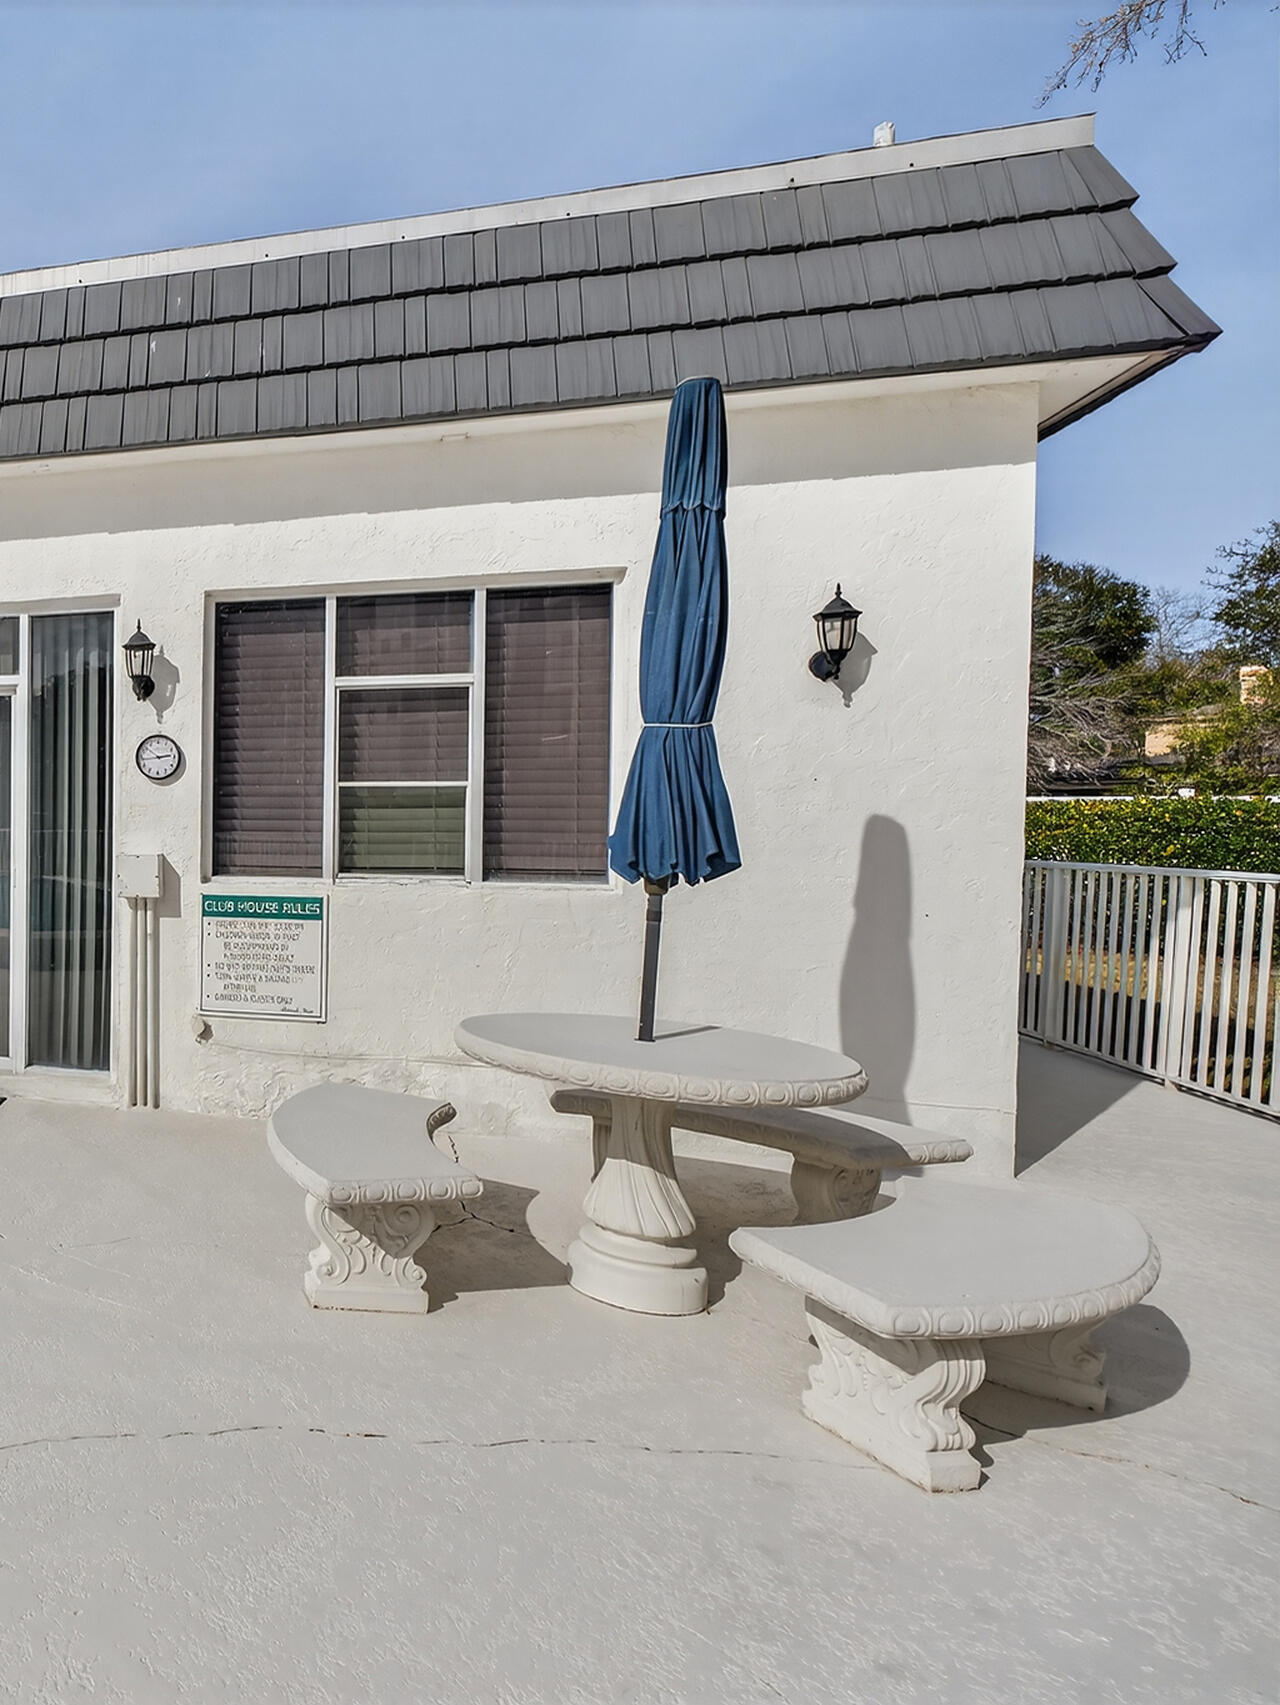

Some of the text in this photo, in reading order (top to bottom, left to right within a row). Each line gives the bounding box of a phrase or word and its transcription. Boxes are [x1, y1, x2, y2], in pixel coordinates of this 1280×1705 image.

[204, 900, 321, 915] CLUB HOUSE RULES
